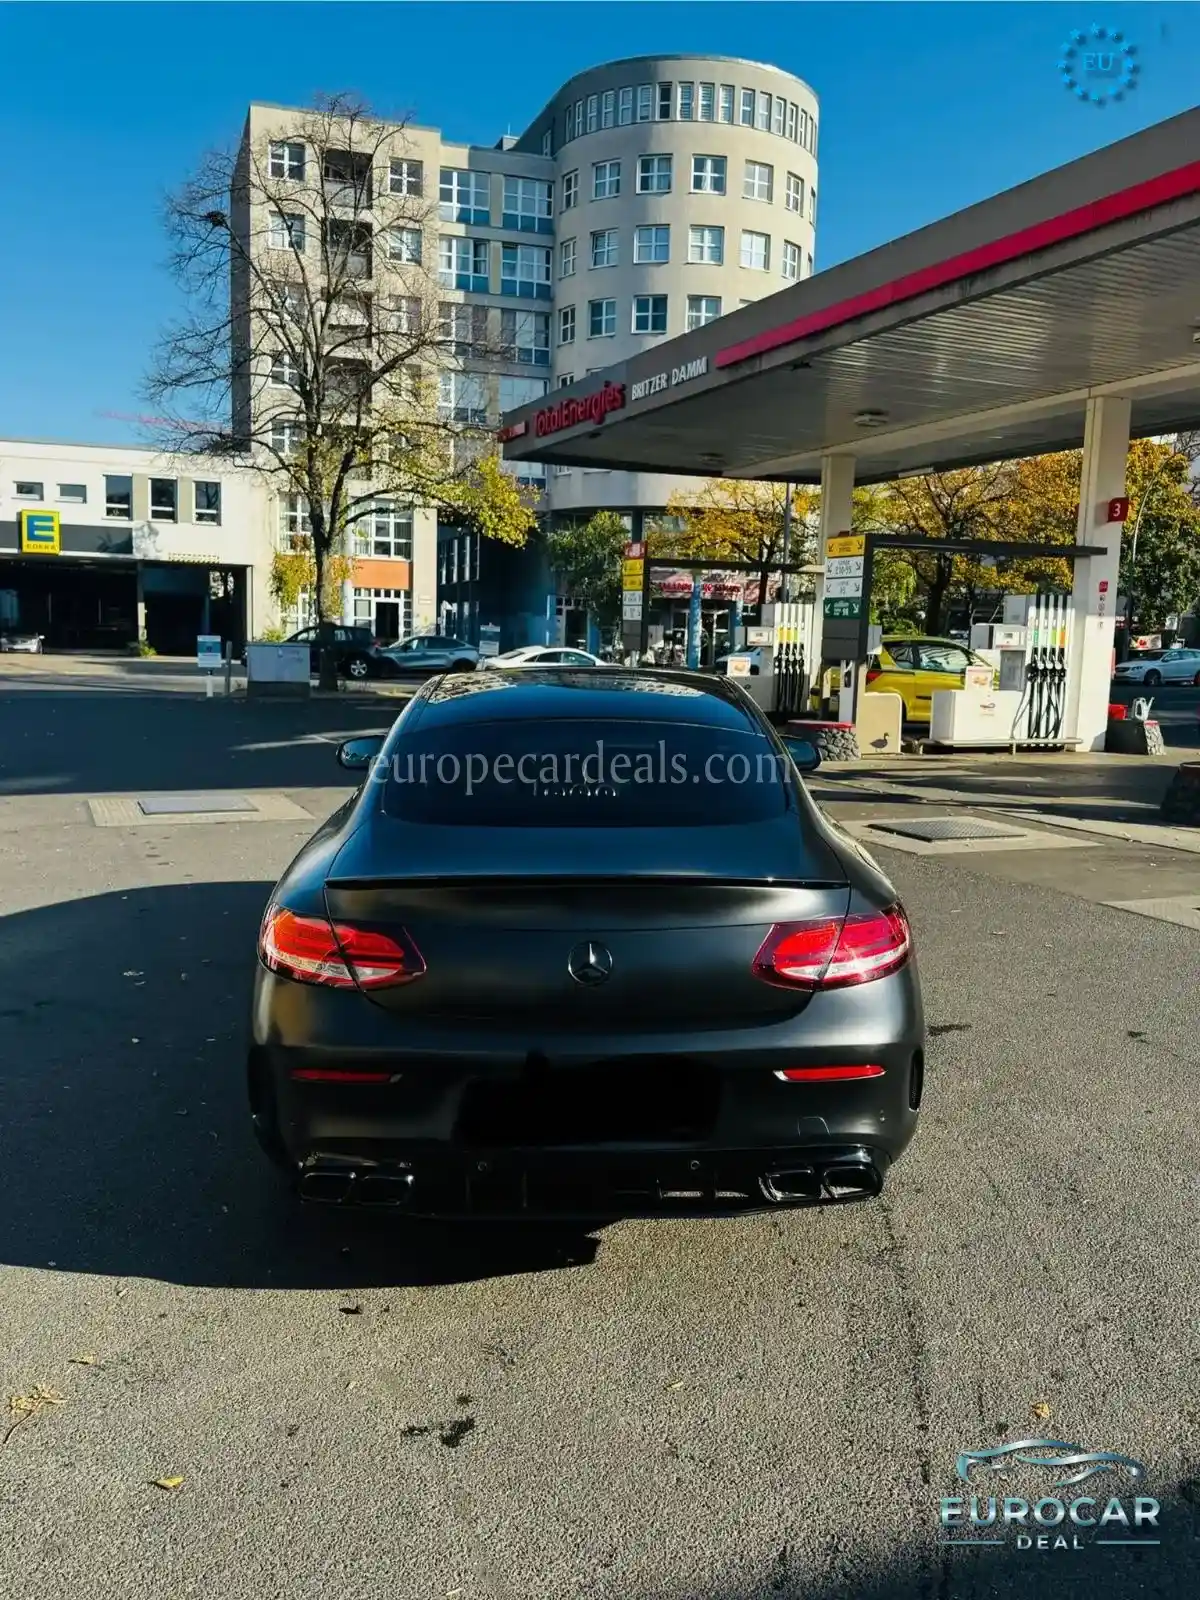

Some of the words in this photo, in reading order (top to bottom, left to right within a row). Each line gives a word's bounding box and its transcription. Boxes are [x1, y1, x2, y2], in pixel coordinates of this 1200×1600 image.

[631, 373, 668, 401] BRITZER
[671, 356, 708, 386] DAMM
[533, 382, 624, 436] TotalEnergies
[1112, 503, 1121, 517] 3
[27, 515, 54, 542] E
